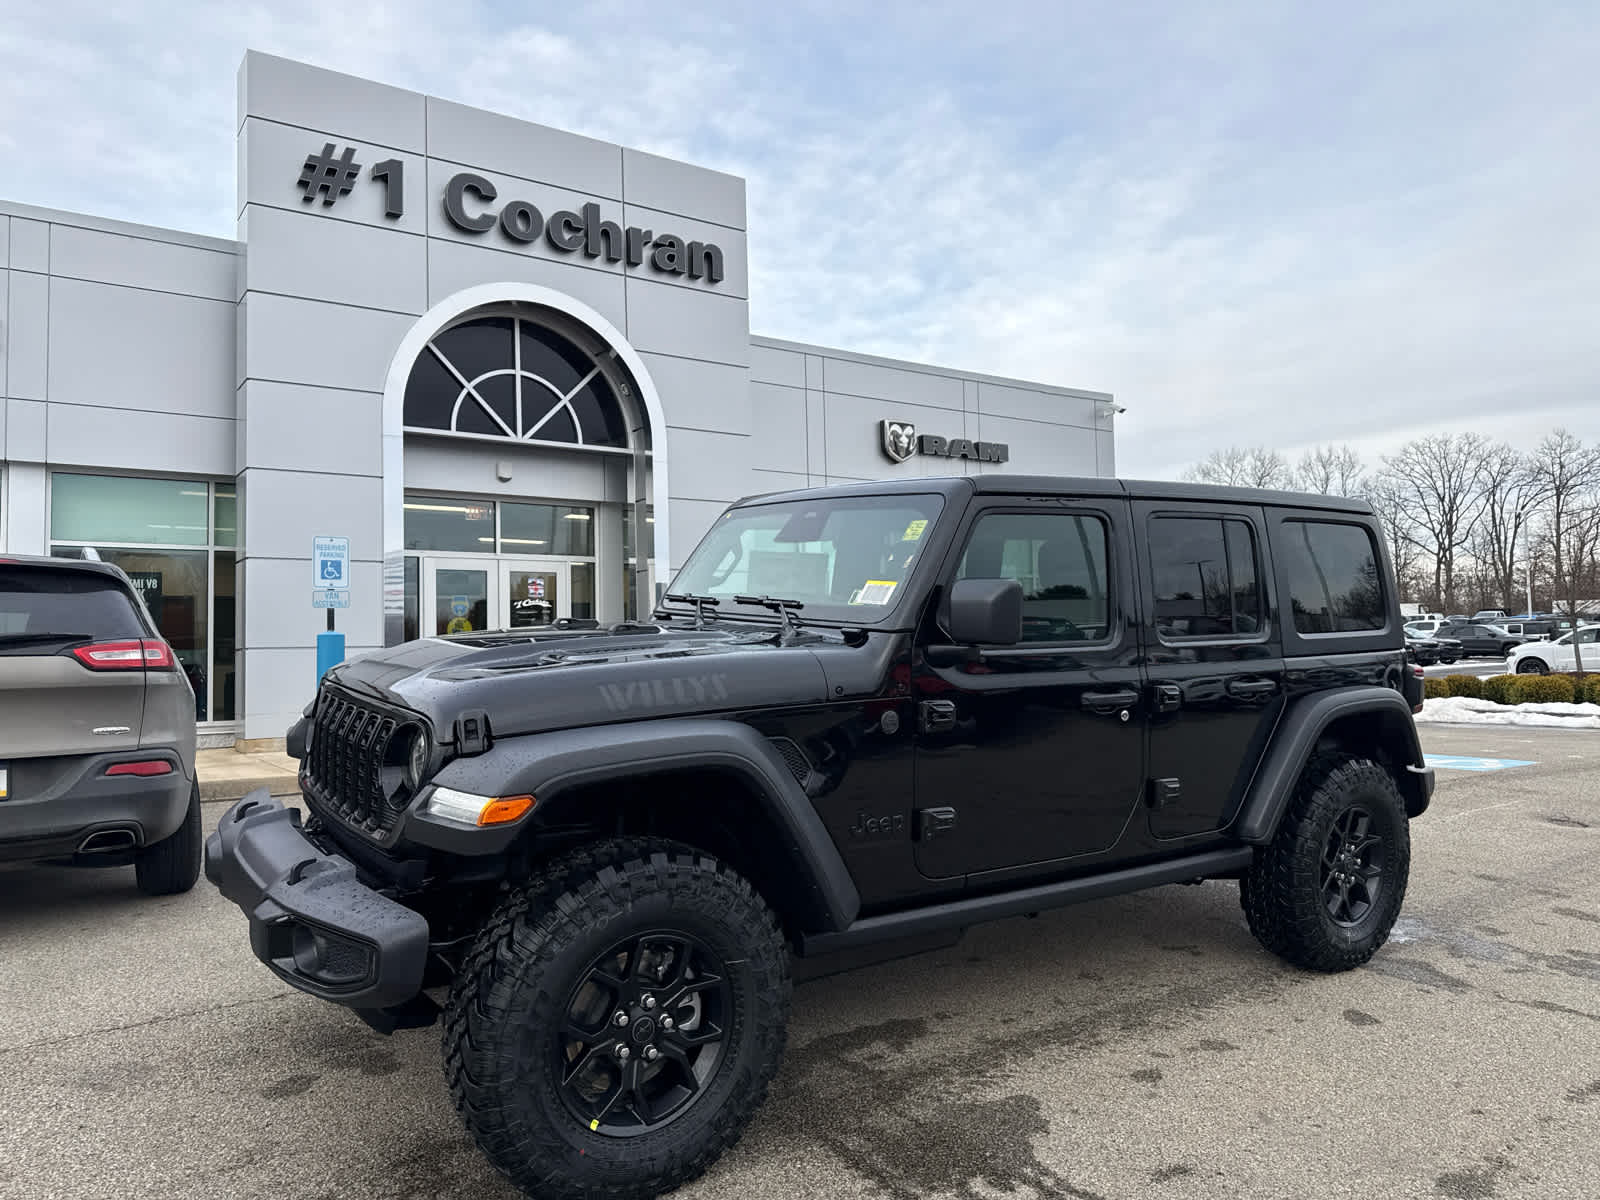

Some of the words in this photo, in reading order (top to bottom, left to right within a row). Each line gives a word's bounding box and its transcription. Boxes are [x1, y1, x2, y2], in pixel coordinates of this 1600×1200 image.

[297, 143, 404, 219] #1
[442, 172, 725, 283] Cochran
[917, 434, 1009, 463] RAM
[146, 578, 158, 589] V8
[596, 672, 728, 712] WILLYS
[849, 811, 904, 836] Jeep
